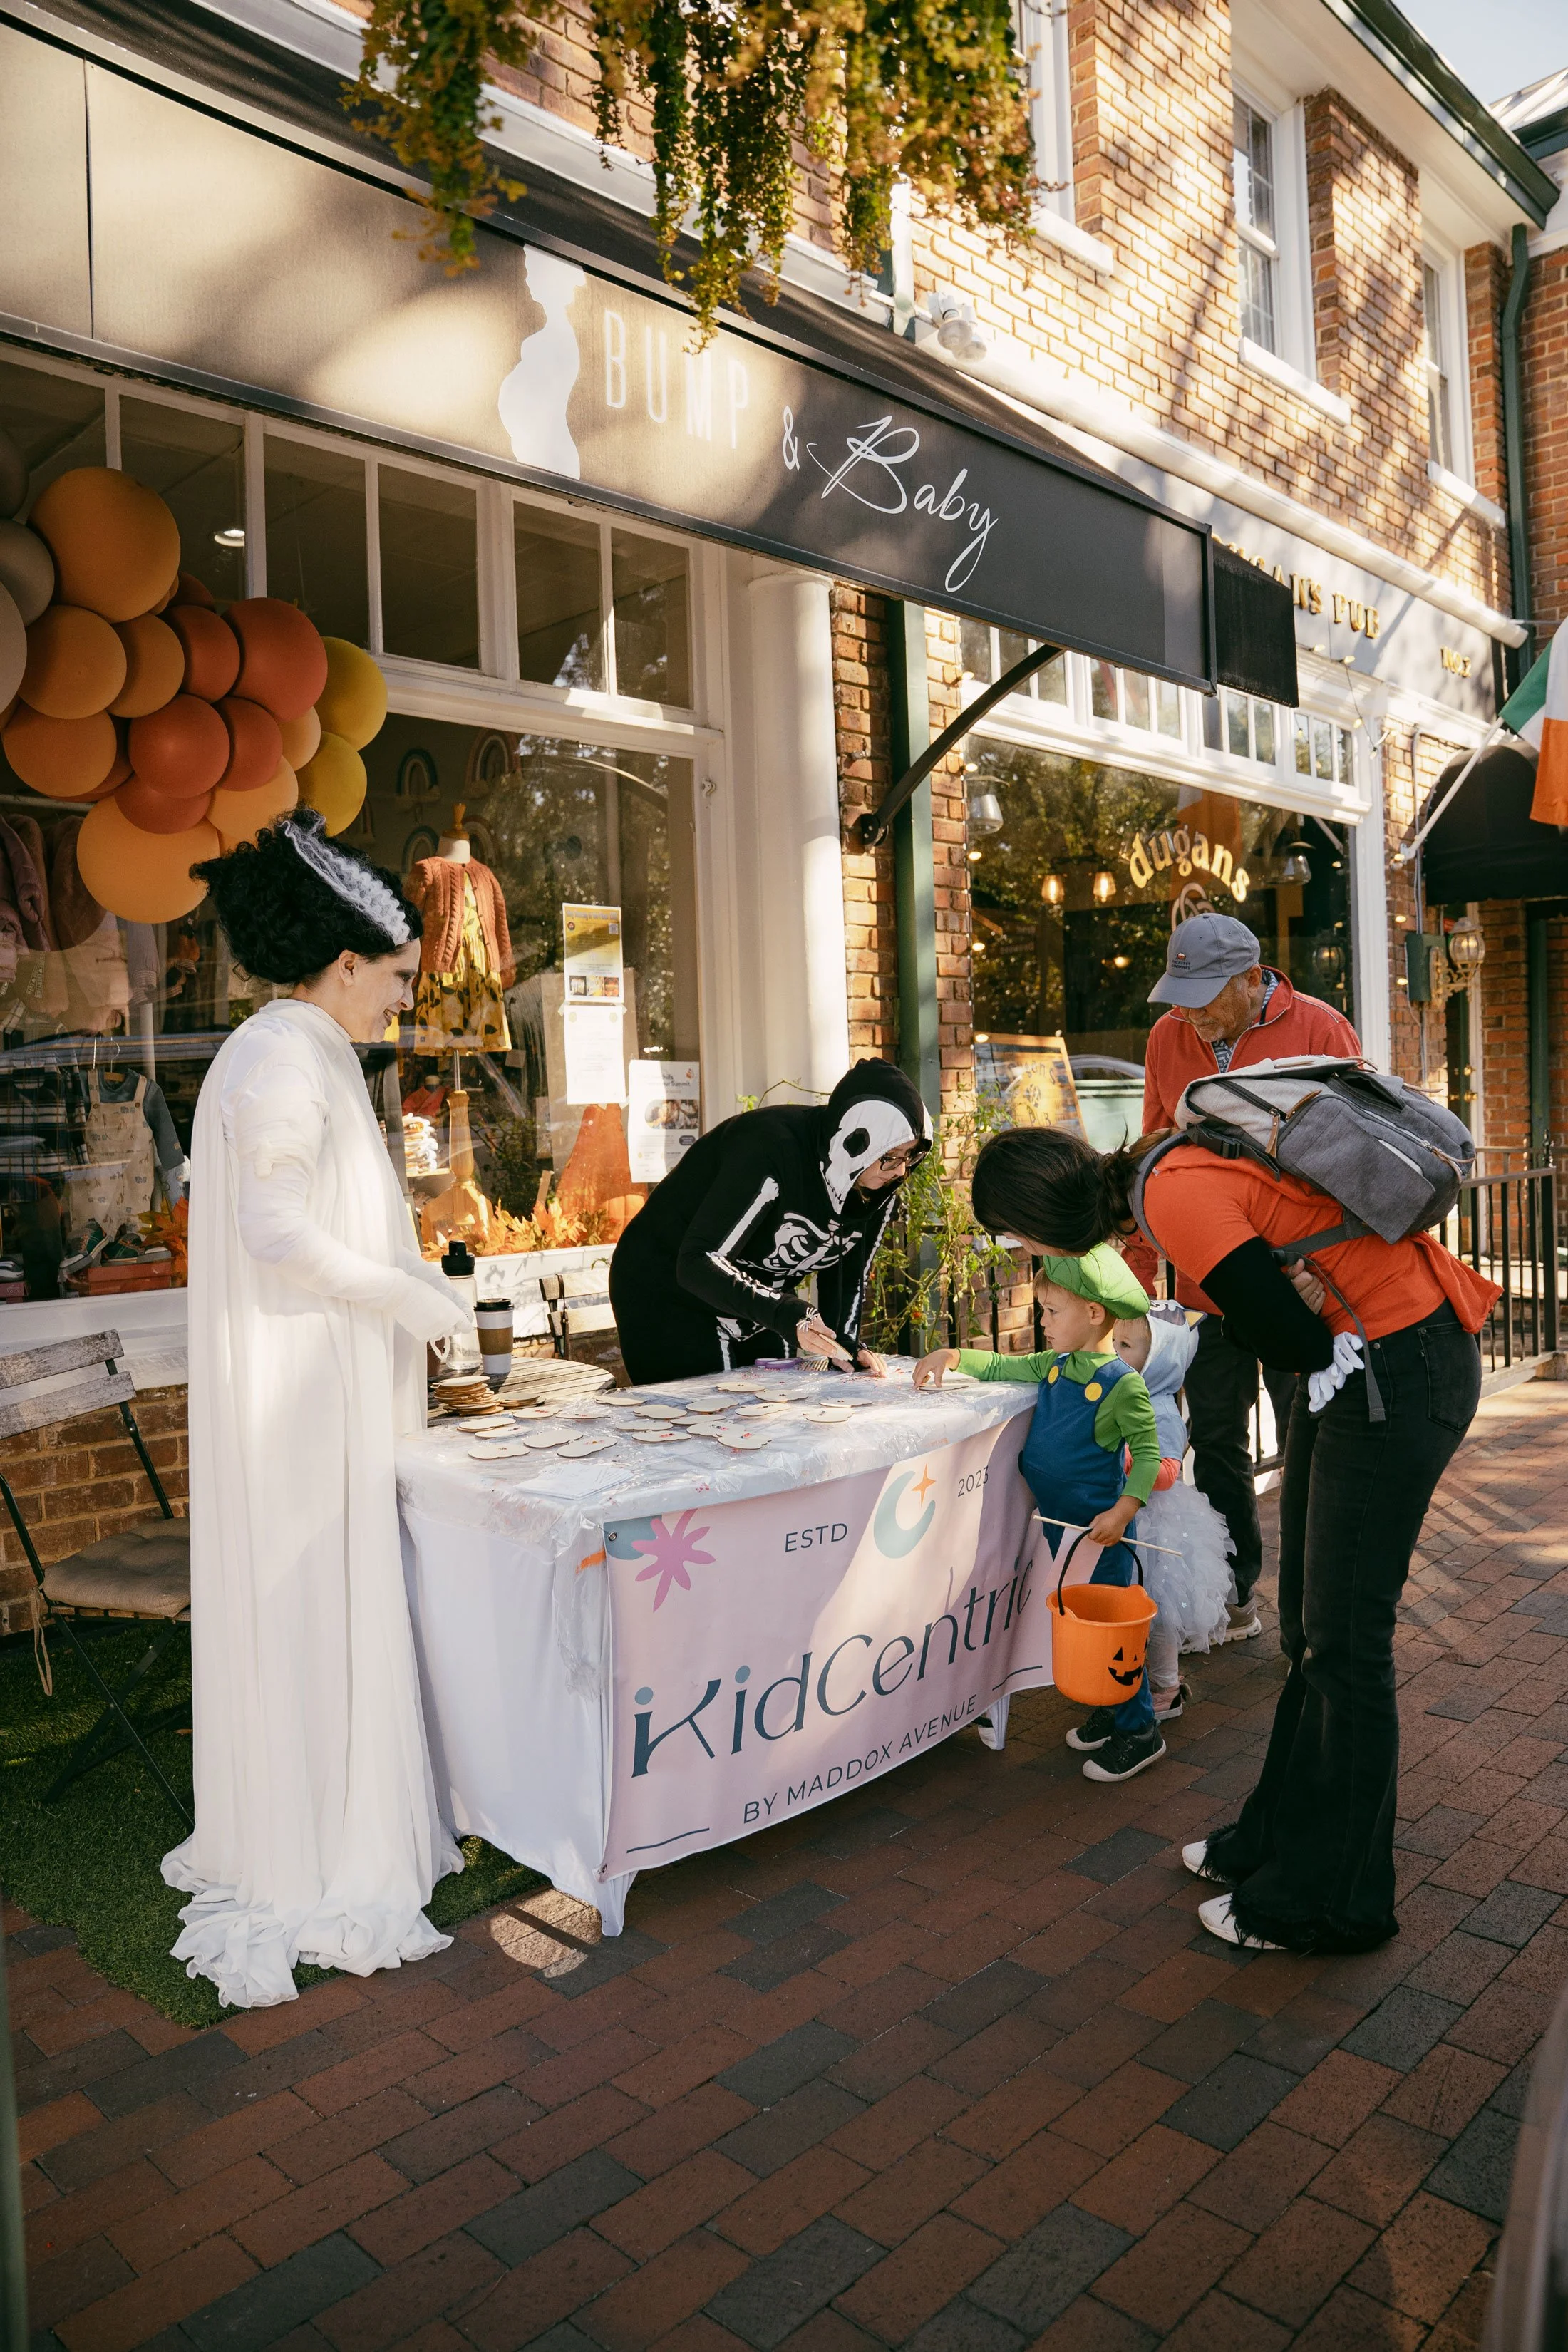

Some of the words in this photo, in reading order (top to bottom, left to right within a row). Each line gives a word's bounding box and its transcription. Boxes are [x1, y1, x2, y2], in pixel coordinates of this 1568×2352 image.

[604, 309, 749, 450] BUMP
[783, 406, 800, 472] &
[807, 416, 999, 592] Baby
[1332, 591, 1381, 639] PUB
[1129, 825, 1251, 903] dugans
[784, 1522, 848, 1554] ESTD
[957, 1465, 989, 1497] 2023
[631, 1556, 1033, 1779] KidCentric
[743, 1793, 778, 1825] BY
[786, 1740, 893, 1807] MADDOX
[899, 1693, 977, 1754] AVENUE
